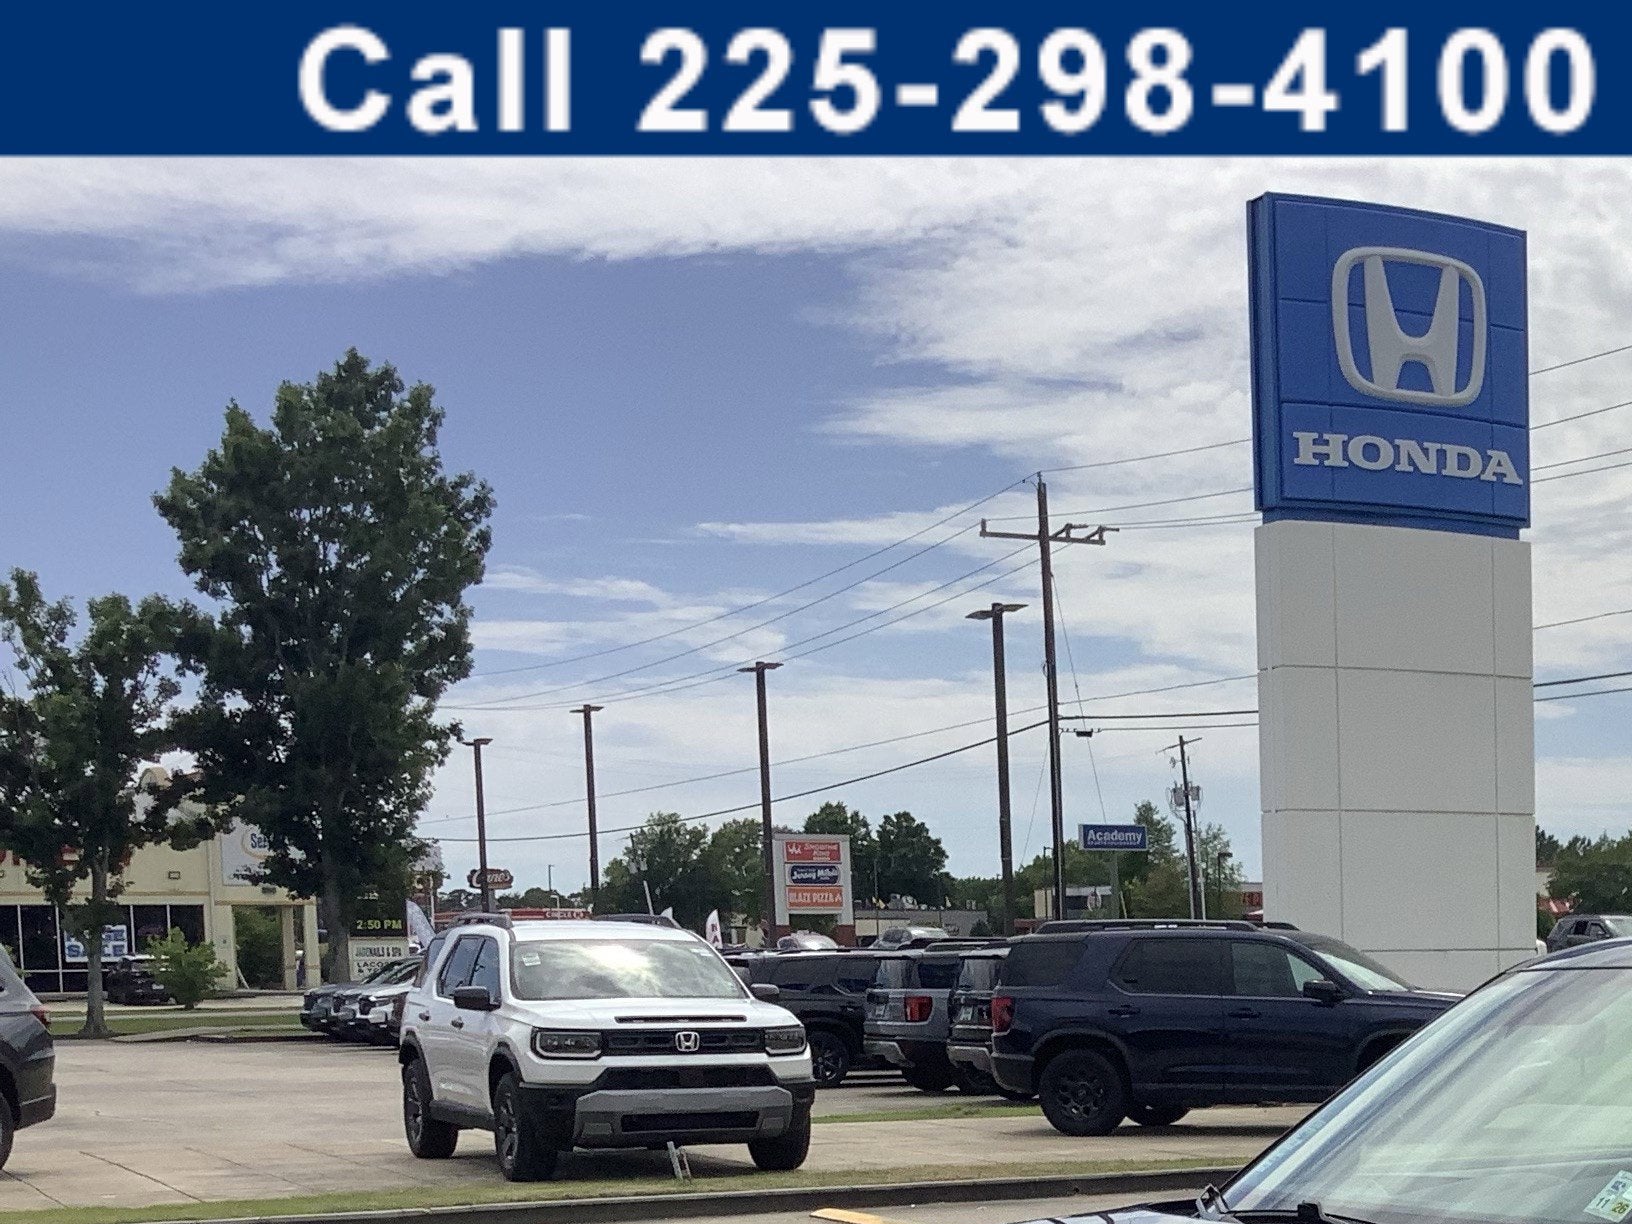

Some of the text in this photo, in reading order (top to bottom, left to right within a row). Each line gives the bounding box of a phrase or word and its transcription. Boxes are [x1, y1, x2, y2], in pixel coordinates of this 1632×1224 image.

[1293, 432, 1523, 485] HONDA
[1088, 829, 1143, 844] Academy
[383, 919, 402, 930] PM
